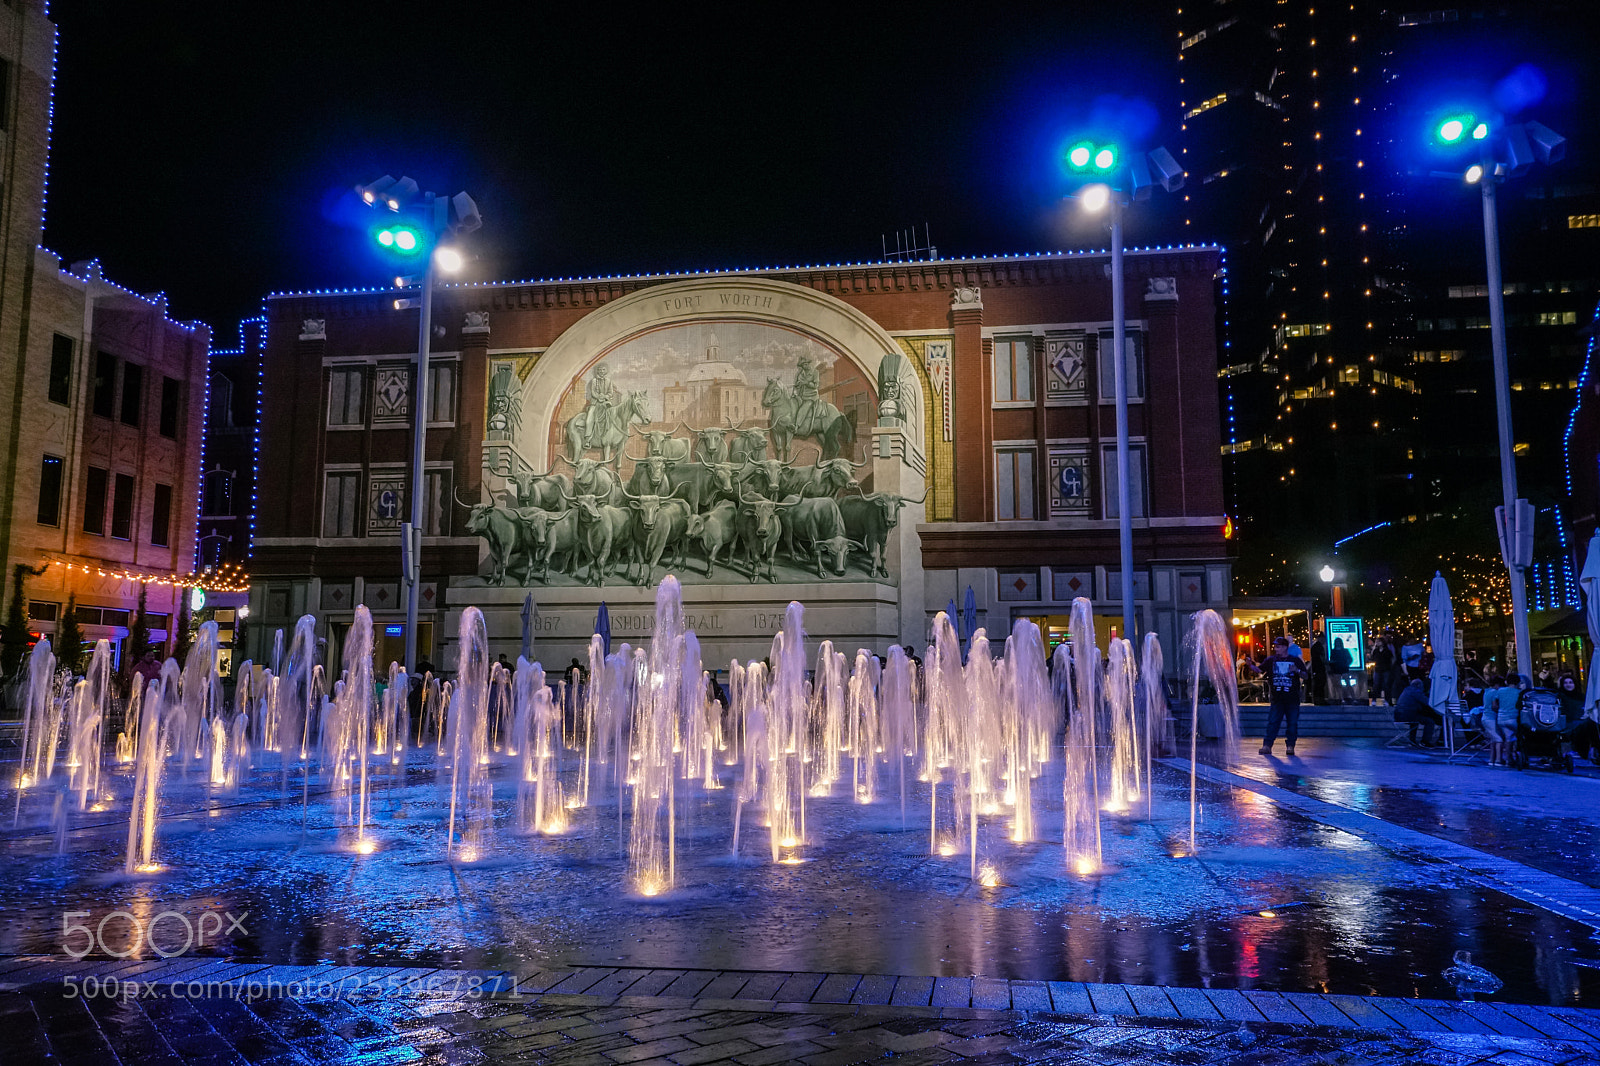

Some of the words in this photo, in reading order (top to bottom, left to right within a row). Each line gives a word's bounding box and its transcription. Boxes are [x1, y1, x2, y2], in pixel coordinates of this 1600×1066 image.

[663, 295, 702, 311] FORT
[719, 293, 773, 309] WORTH
[532, 615, 561, 631] 867
[592, 615, 658, 630] CISHOL
[684, 615, 723, 630] RAIL
